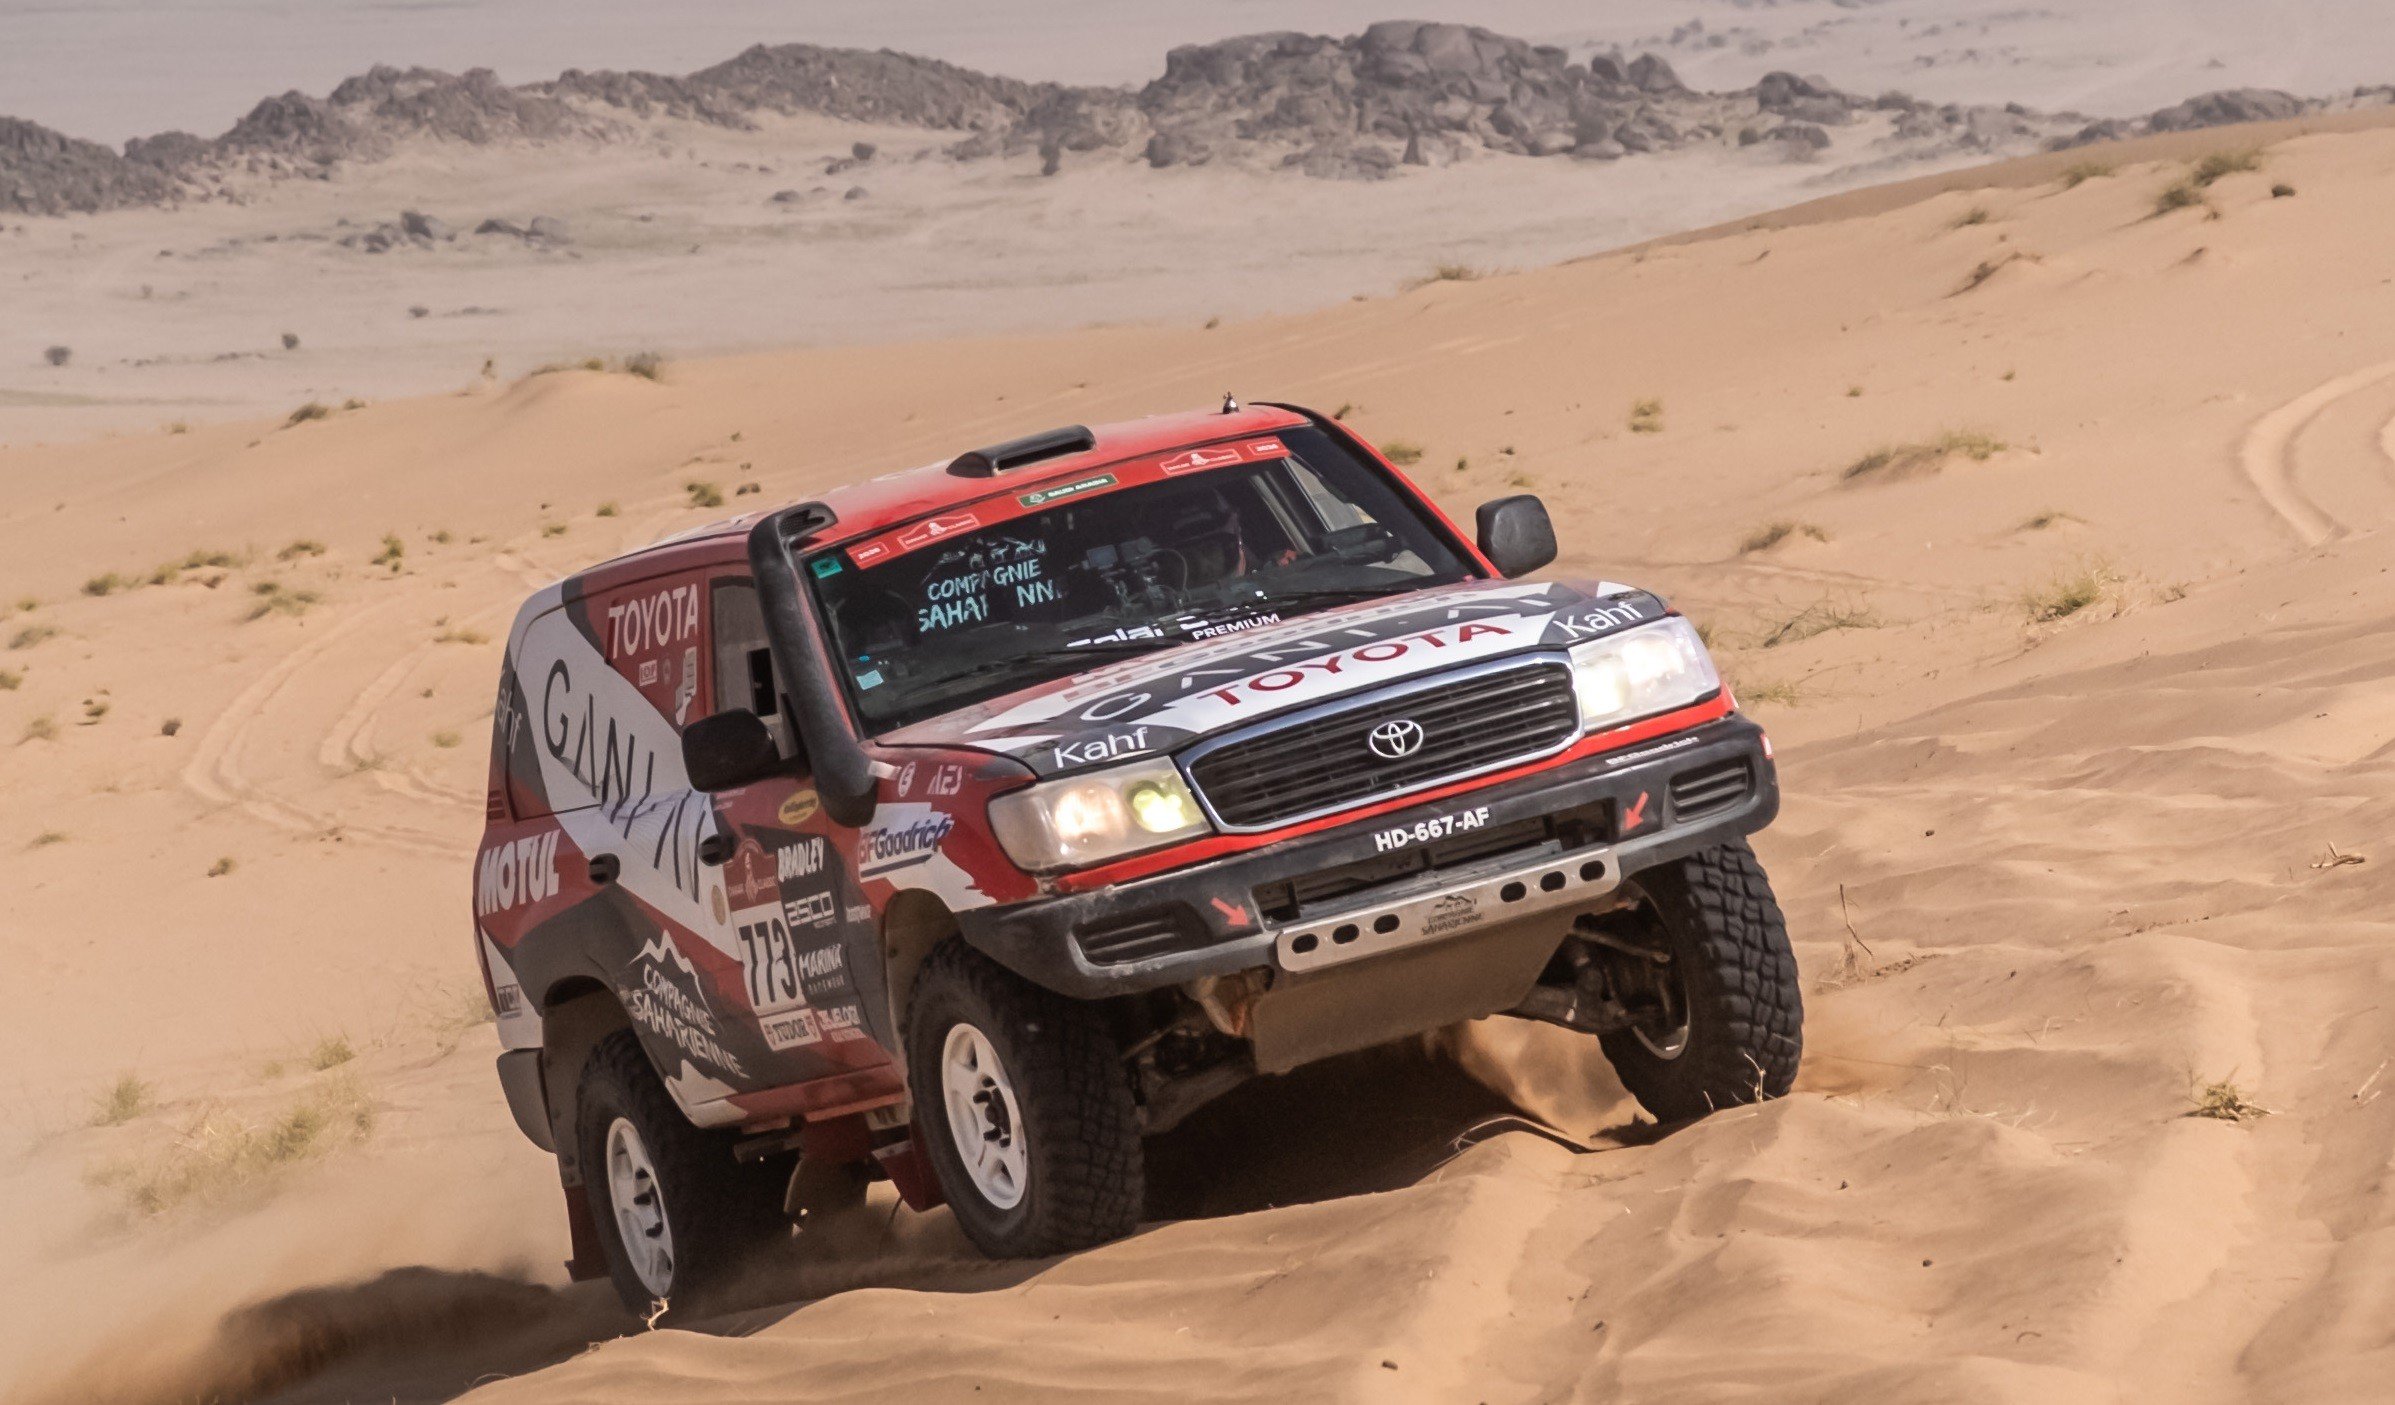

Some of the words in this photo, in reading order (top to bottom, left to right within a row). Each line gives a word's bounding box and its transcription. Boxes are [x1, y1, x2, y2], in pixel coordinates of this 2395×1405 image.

[1047, 485, 1074, 498] SAUDI
[608, 583, 698, 660] TOYOTA
[1192, 613, 1281, 640] PREMIUM
[1556, 601, 1644, 639] Kahf
[1197, 623, 1512, 706] TOYOTA
[1054, 727, 1148, 769] Kahf
[1374, 807, 1490, 852] HD-667-AF
[479, 829, 561, 917] MOTUL
[778, 836, 824, 883] BRADLEY
[738, 917, 798, 1007] 773
[643, 963, 717, 1036] COMPAGNIE
[629, 989, 751, 1080] SAHARIENNE
[772, 1017, 810, 1042] TUDOR
